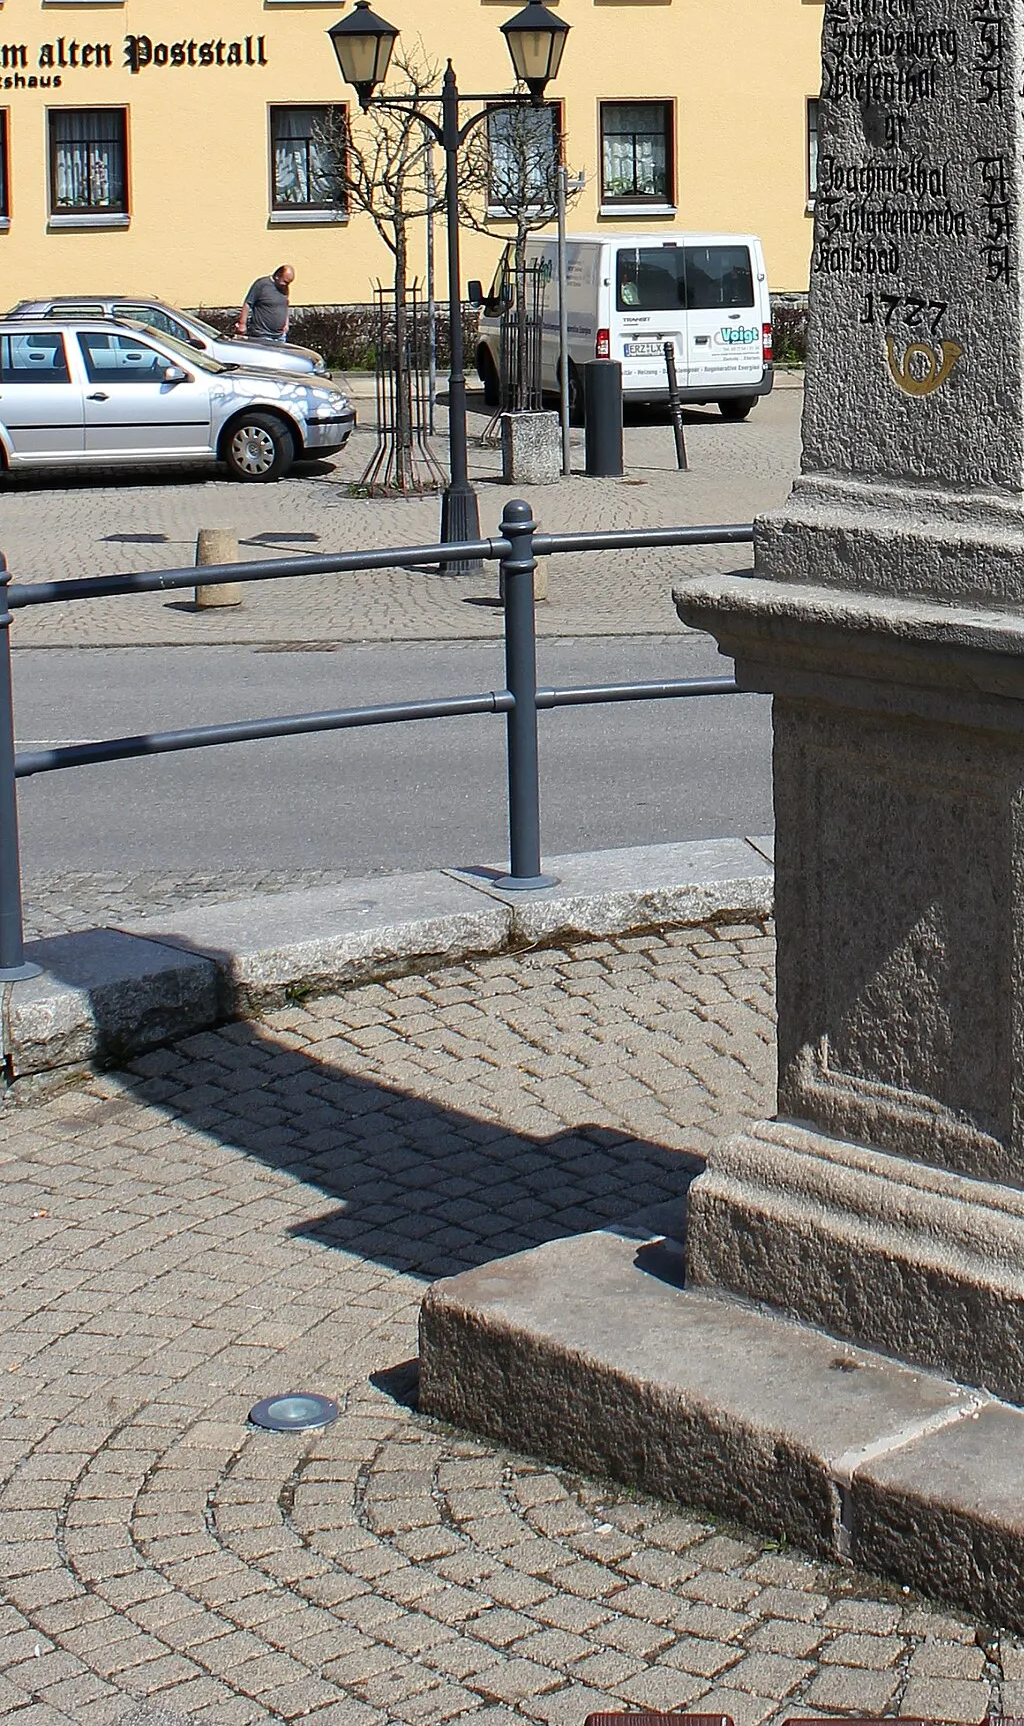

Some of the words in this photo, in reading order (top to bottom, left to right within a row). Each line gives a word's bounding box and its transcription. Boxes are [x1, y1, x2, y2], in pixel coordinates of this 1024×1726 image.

[0, 44, 28, 69] m
[38, 36, 113, 69] alten
[122, 34, 268, 74] Poststall
[860, 293, 948, 335] 1727
[720, 325, 760, 345] Voigt
